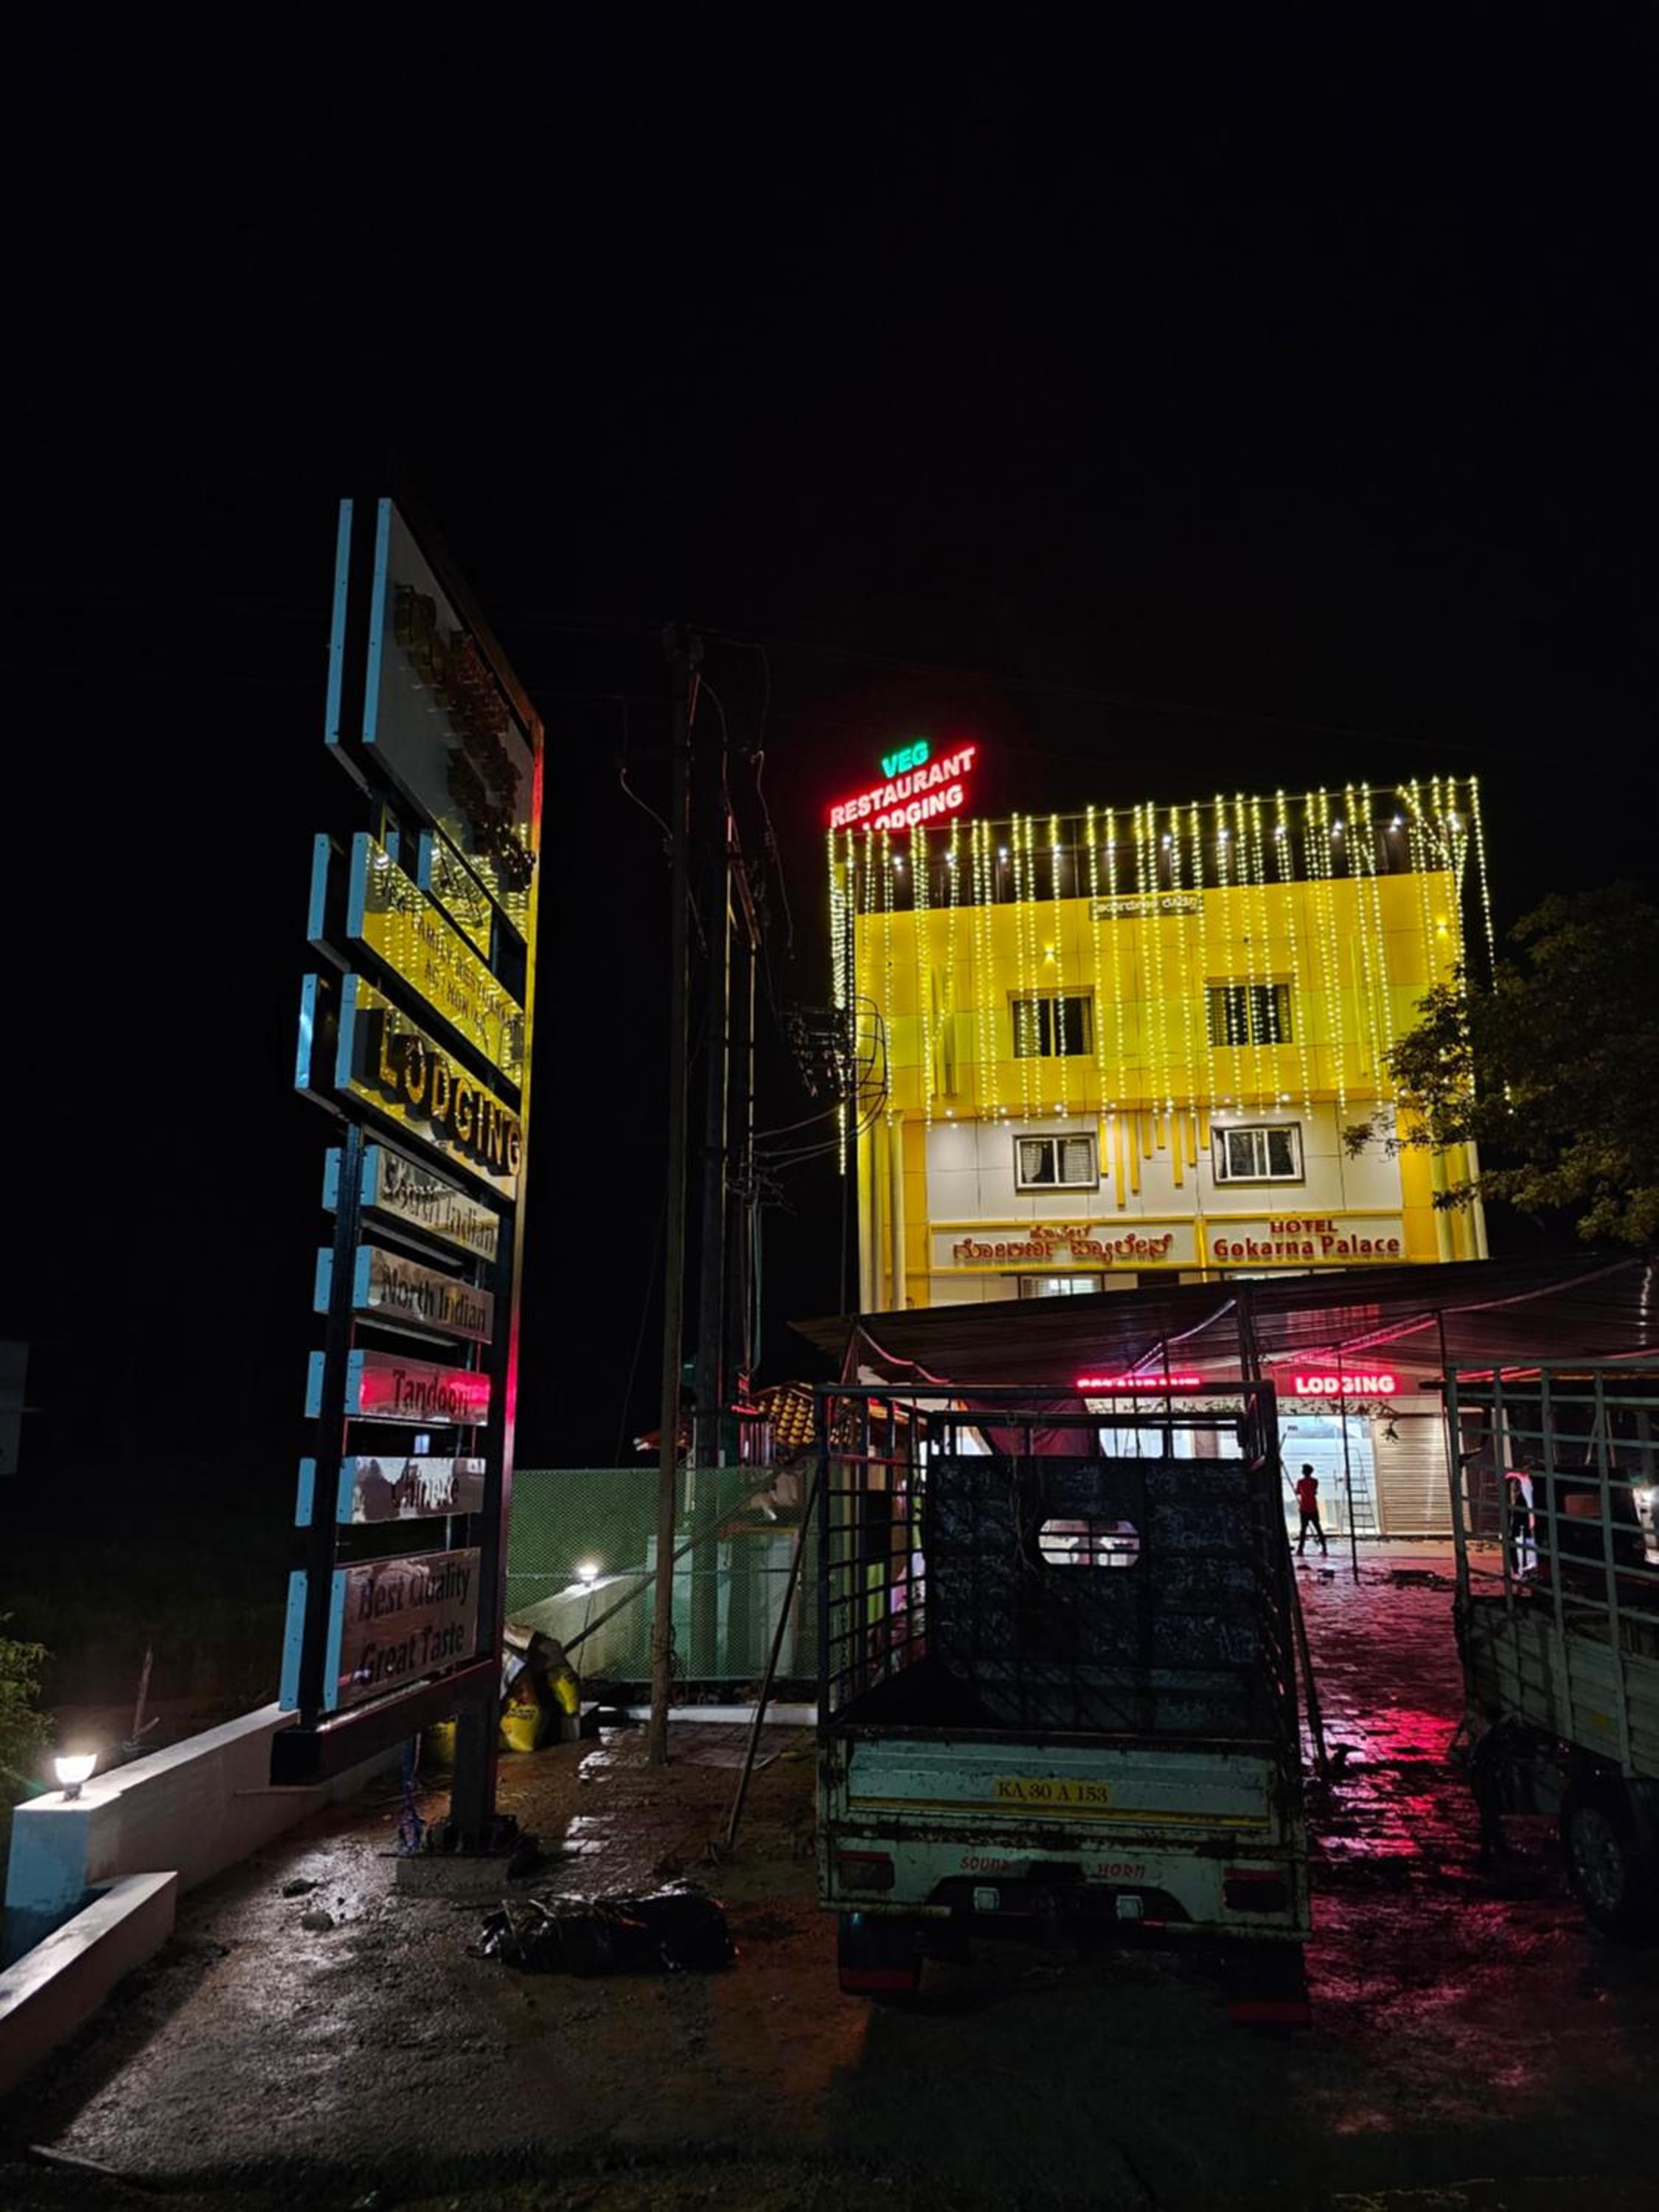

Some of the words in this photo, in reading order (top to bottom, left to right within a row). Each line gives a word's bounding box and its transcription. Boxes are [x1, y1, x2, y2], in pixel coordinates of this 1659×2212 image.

[882, 740, 929, 779] VEG
[830, 746, 975, 827] RESTAURANT
[862, 784, 964, 830] ODGING
[378, 1007, 522, 1180] LODGING
[445, 1195, 496, 1254] Indian
[1213, 1237, 1315, 1257] Gokarna
[1320, 1234, 1400, 1256] Palace
[1269, 1219, 1339, 1234] HOTEL
[381, 1263, 435, 1318] North
[439, 1286, 487, 1333] Indian
[392, 1368, 469, 1416] Tandoori
[359, 1575, 405, 1621] Best
[408, 1560, 470, 1607] Quality
[361, 1633, 417, 1684] Great
[422, 1621, 465, 1664] Taste
[998, 1781, 1024, 1798] KA
[1057, 1784, 1072, 1801] A
[1096, 1863, 1145, 1877] HORN
